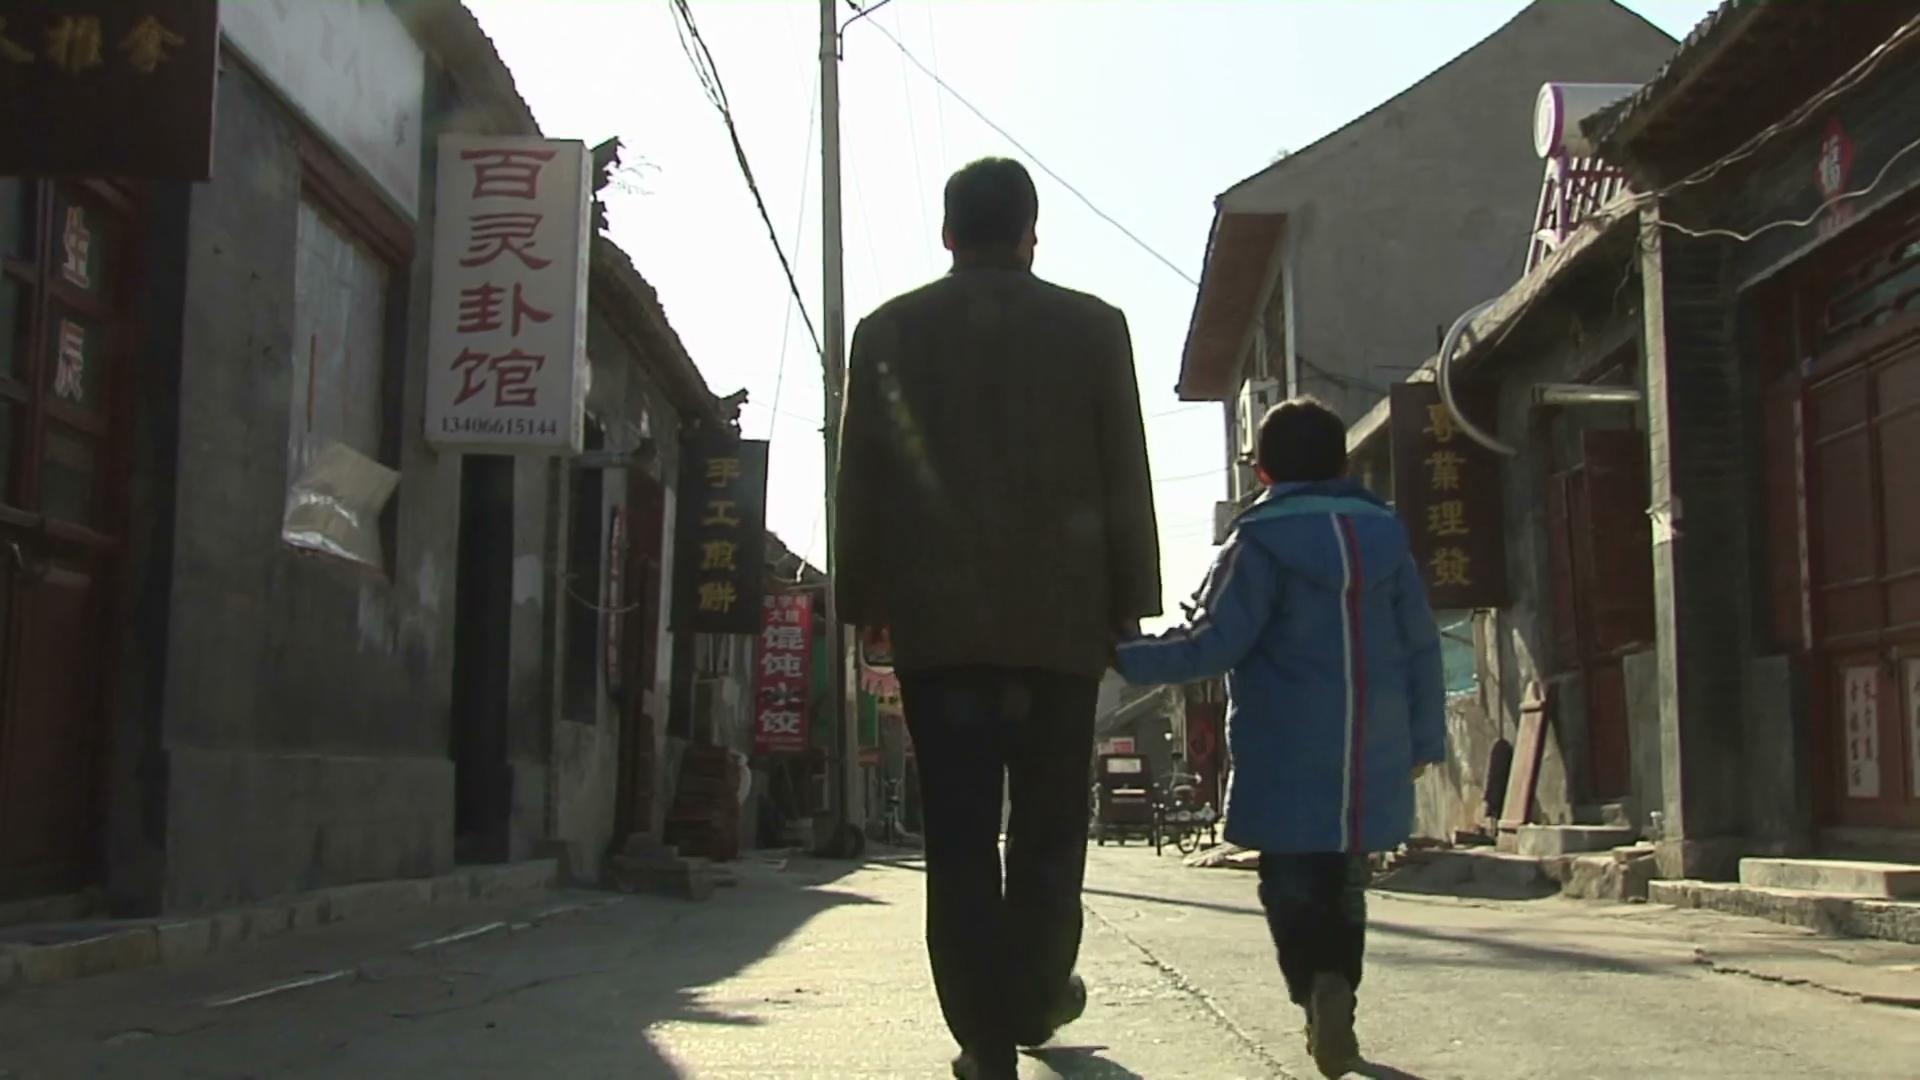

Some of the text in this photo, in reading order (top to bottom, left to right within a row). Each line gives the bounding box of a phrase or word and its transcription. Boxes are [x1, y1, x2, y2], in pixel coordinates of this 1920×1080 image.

[450, 149, 558, 408] 百灵卦馆
[441, 417, 557, 435] 13406615144
[759, 625, 805, 734] 馄饨水饺
